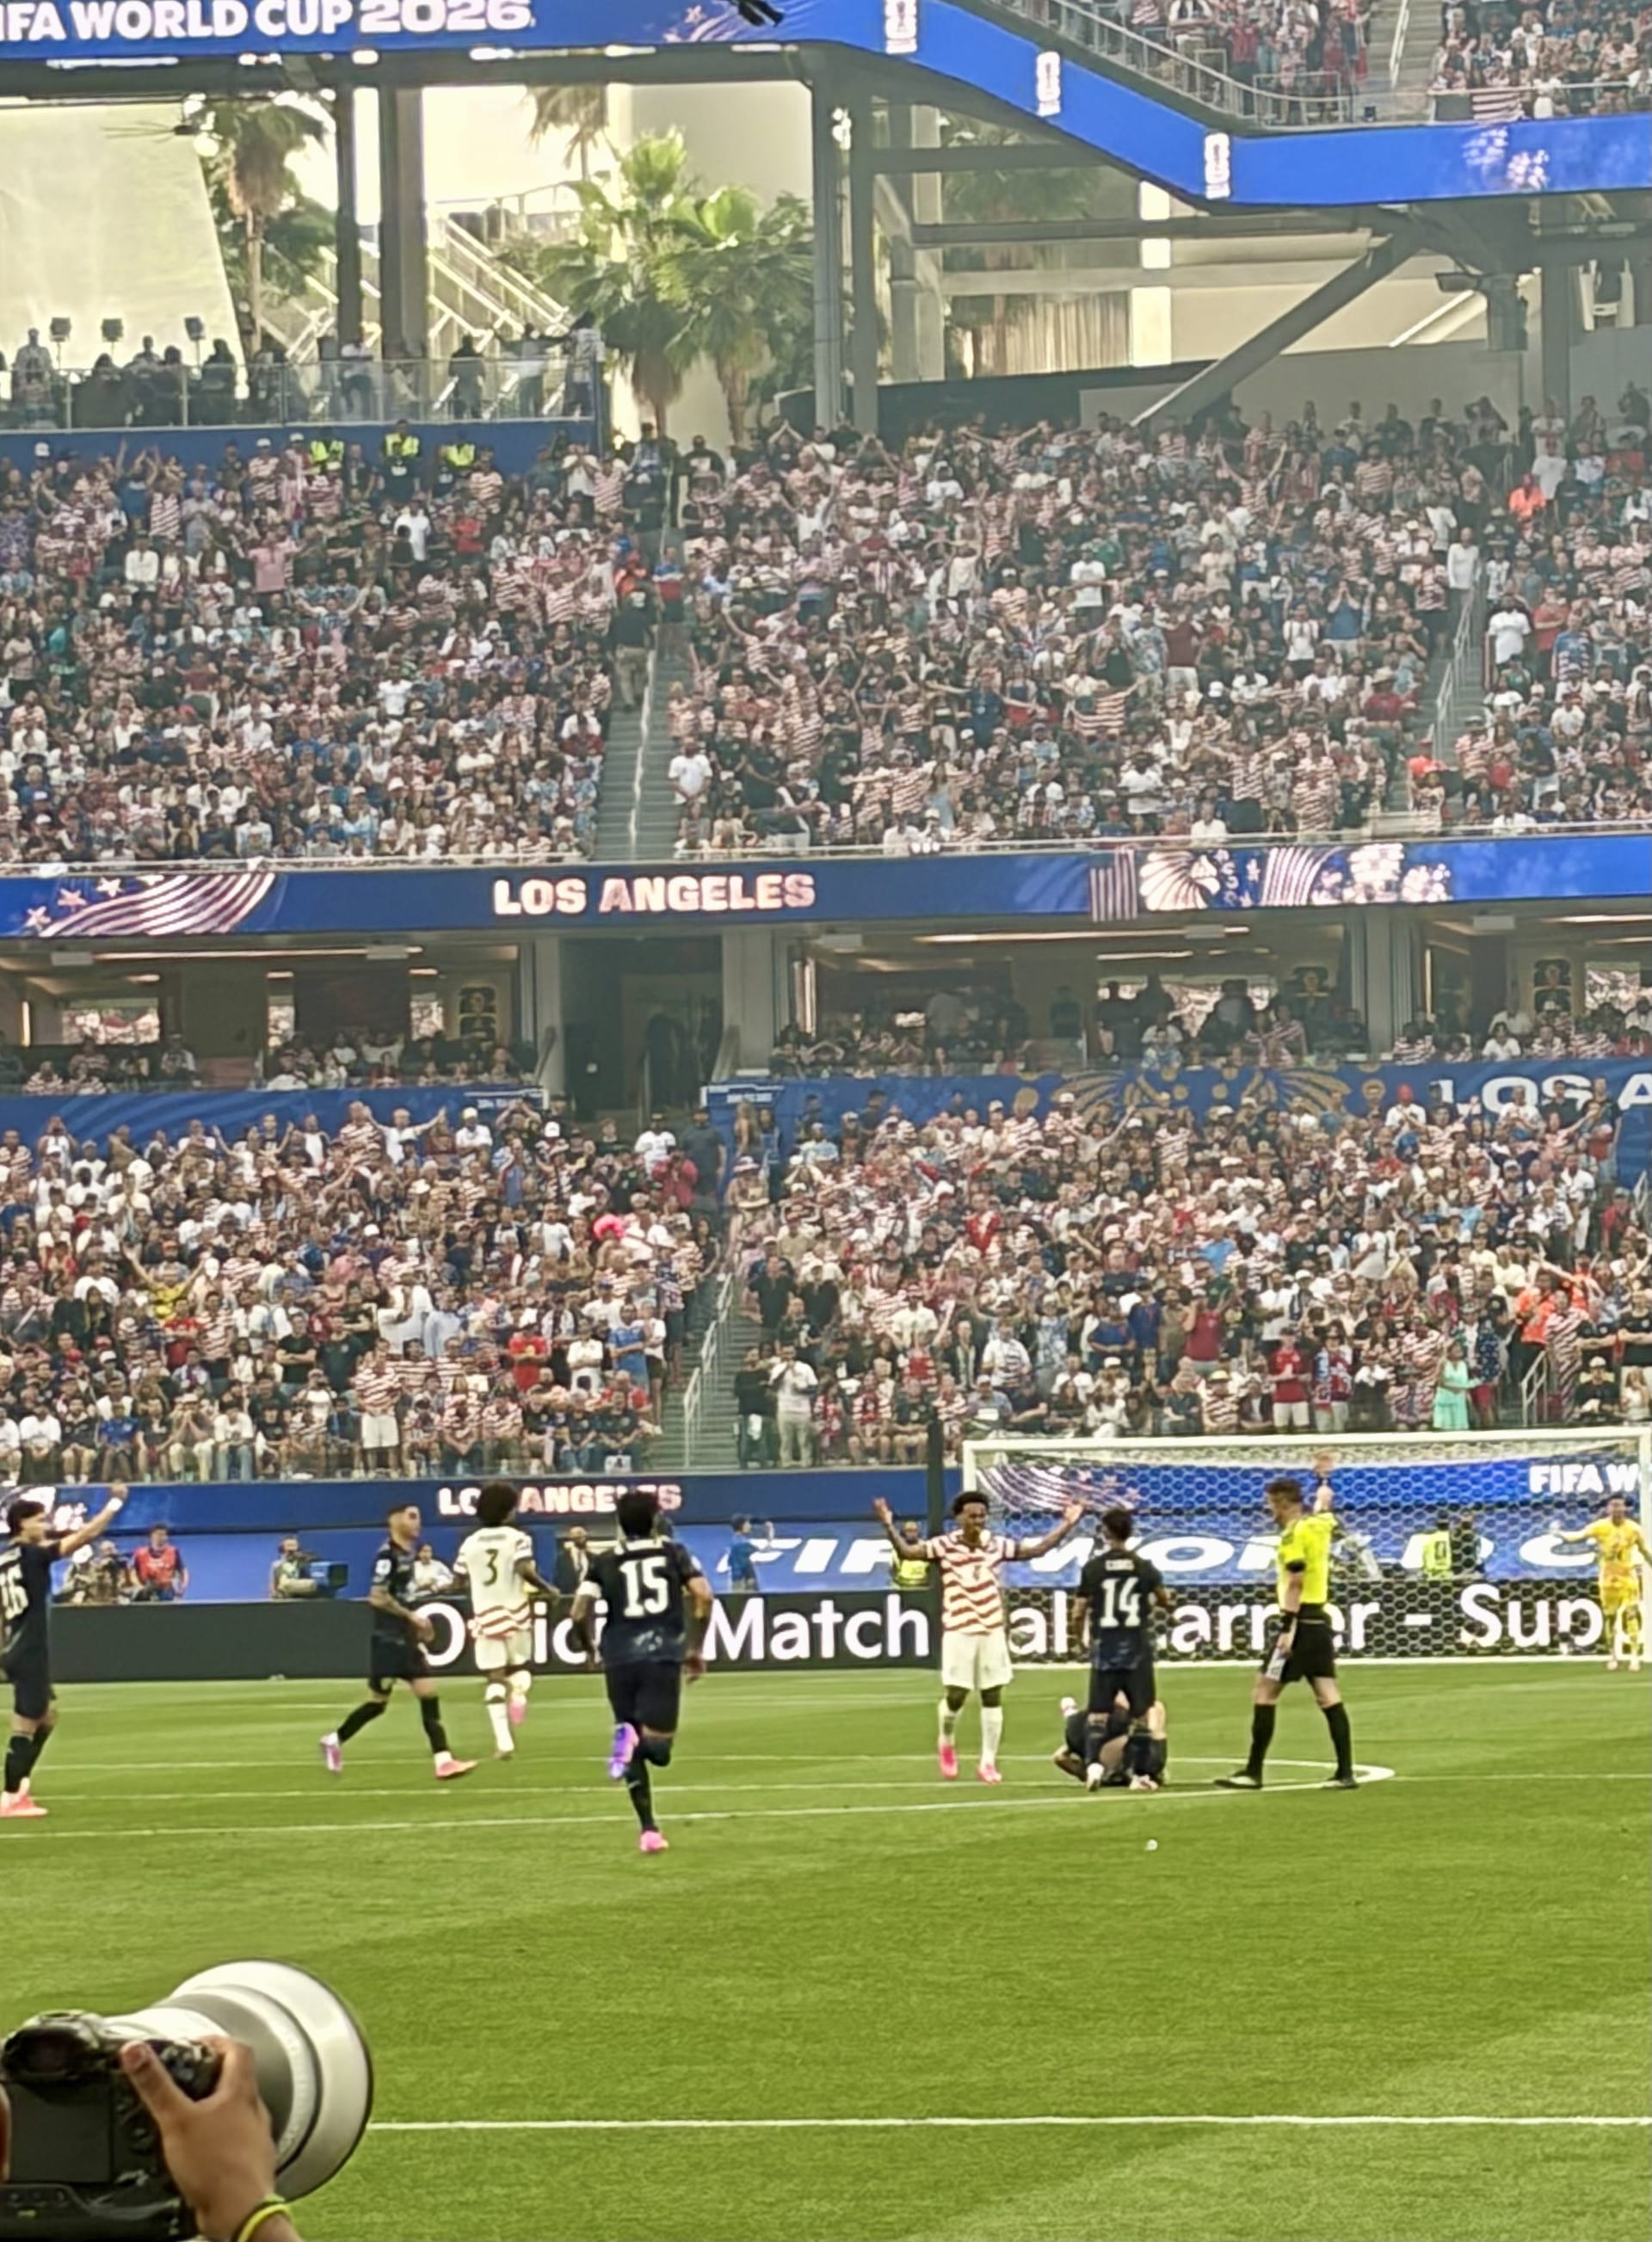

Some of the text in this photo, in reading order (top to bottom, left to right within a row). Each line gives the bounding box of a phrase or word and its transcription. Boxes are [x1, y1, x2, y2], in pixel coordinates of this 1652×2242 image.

[70, 0, 249, 40] WORLD
[255, 0, 354, 36] CUP
[358, 0, 532, 33] 2026
[493, 873, 817, 915] LOS ANGELES
[1529, 1463, 1605, 1494] FIFA
[438, 1484, 683, 1515] LO ANGES
[483, 1549, 498, 1586] 3
[716, 1538, 895, 1574] FIF
[619, 1555, 669, 1617] 15
[1100, 1577, 1142, 1628] 14
[702, 1593, 930, 1661] Match
